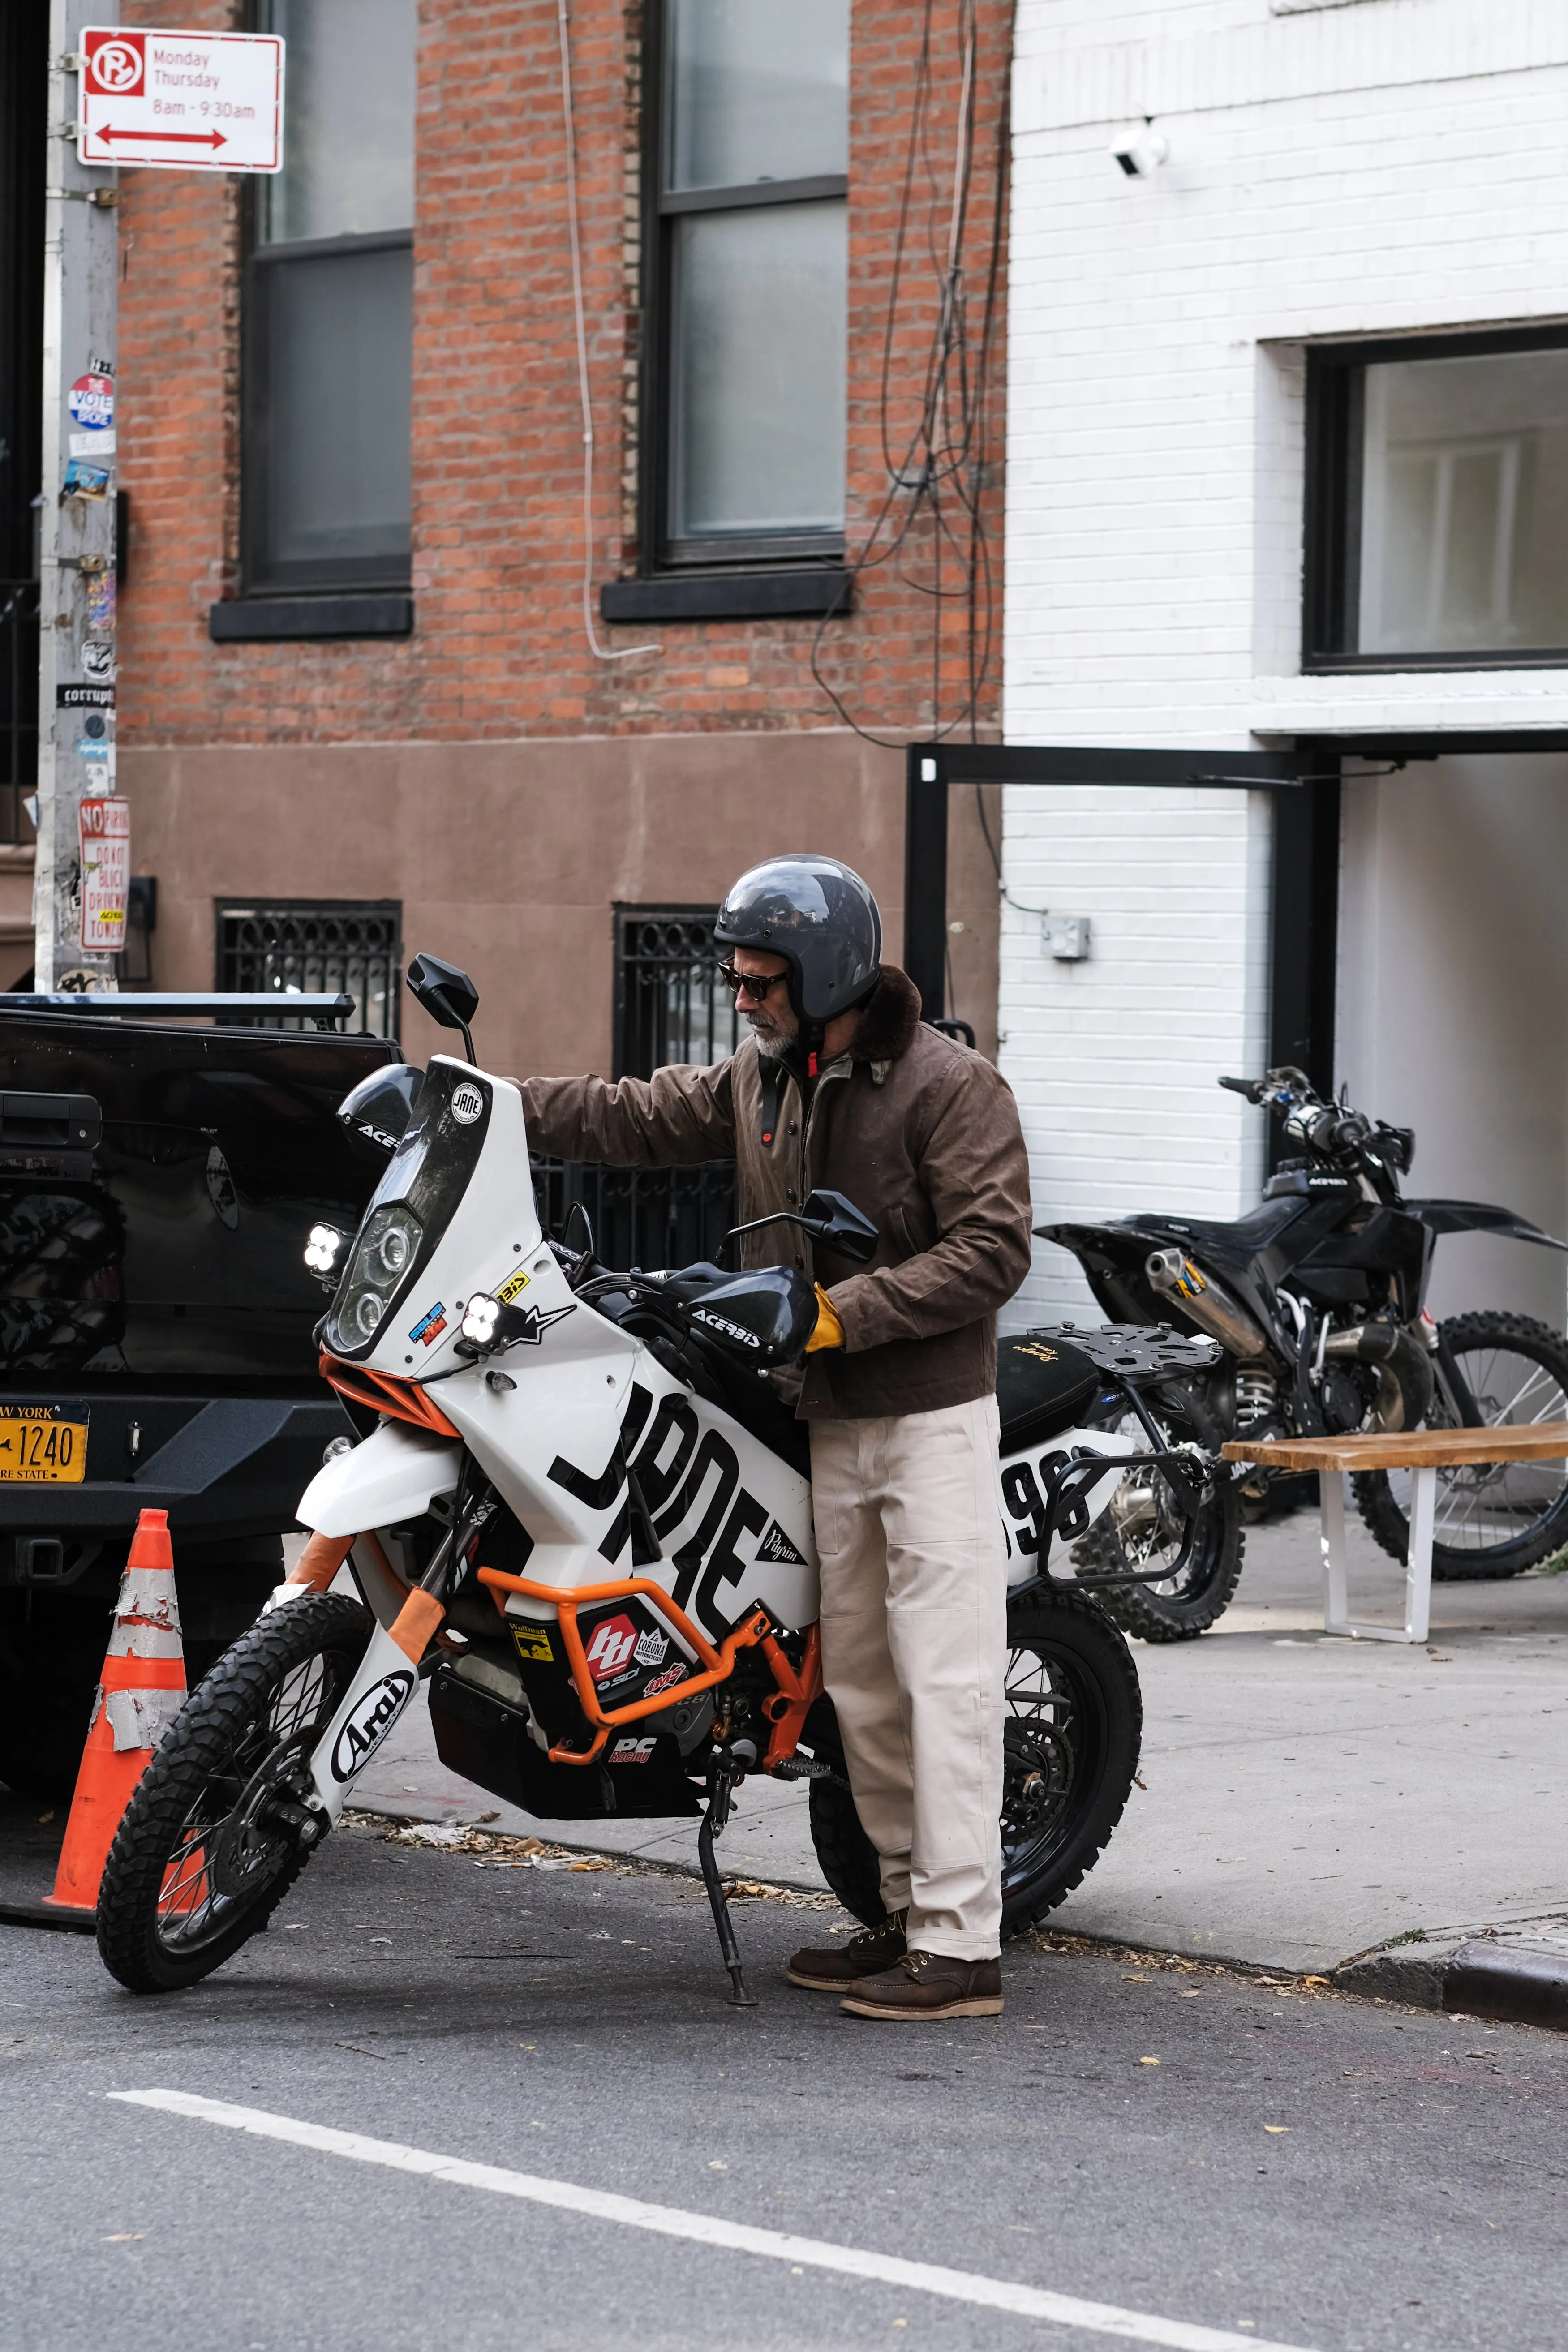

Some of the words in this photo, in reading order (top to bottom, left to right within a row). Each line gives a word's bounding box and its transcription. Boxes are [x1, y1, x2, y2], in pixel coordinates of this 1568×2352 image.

[154, 49, 210, 69] Monday
[155, 69, 220, 91] Thursday
[153, 98, 185, 115] 8am
[81, 805, 103, 833] NO
[453, 1093, 479, 1115] JANE
[548, 1241, 580, 1259] EVO
[410, 1304, 443, 1340] SOLID
[17, 1407, 53, 1420] YORK
[20, 1425, 73, 1466] 1240
[17, 1470, 49, 1479] STATE
[764, 1529, 797, 1562] Pilgrim
[509, 1623, 546, 1634] Wolfman
[638, 1639, 665, 1657] CORONA
[647, 1665, 683, 1694] IMS
[347, 1678, 405, 1778] Arai
[614, 1737, 657, 1753] PC
[608, 1751, 652, 1764] Racing
